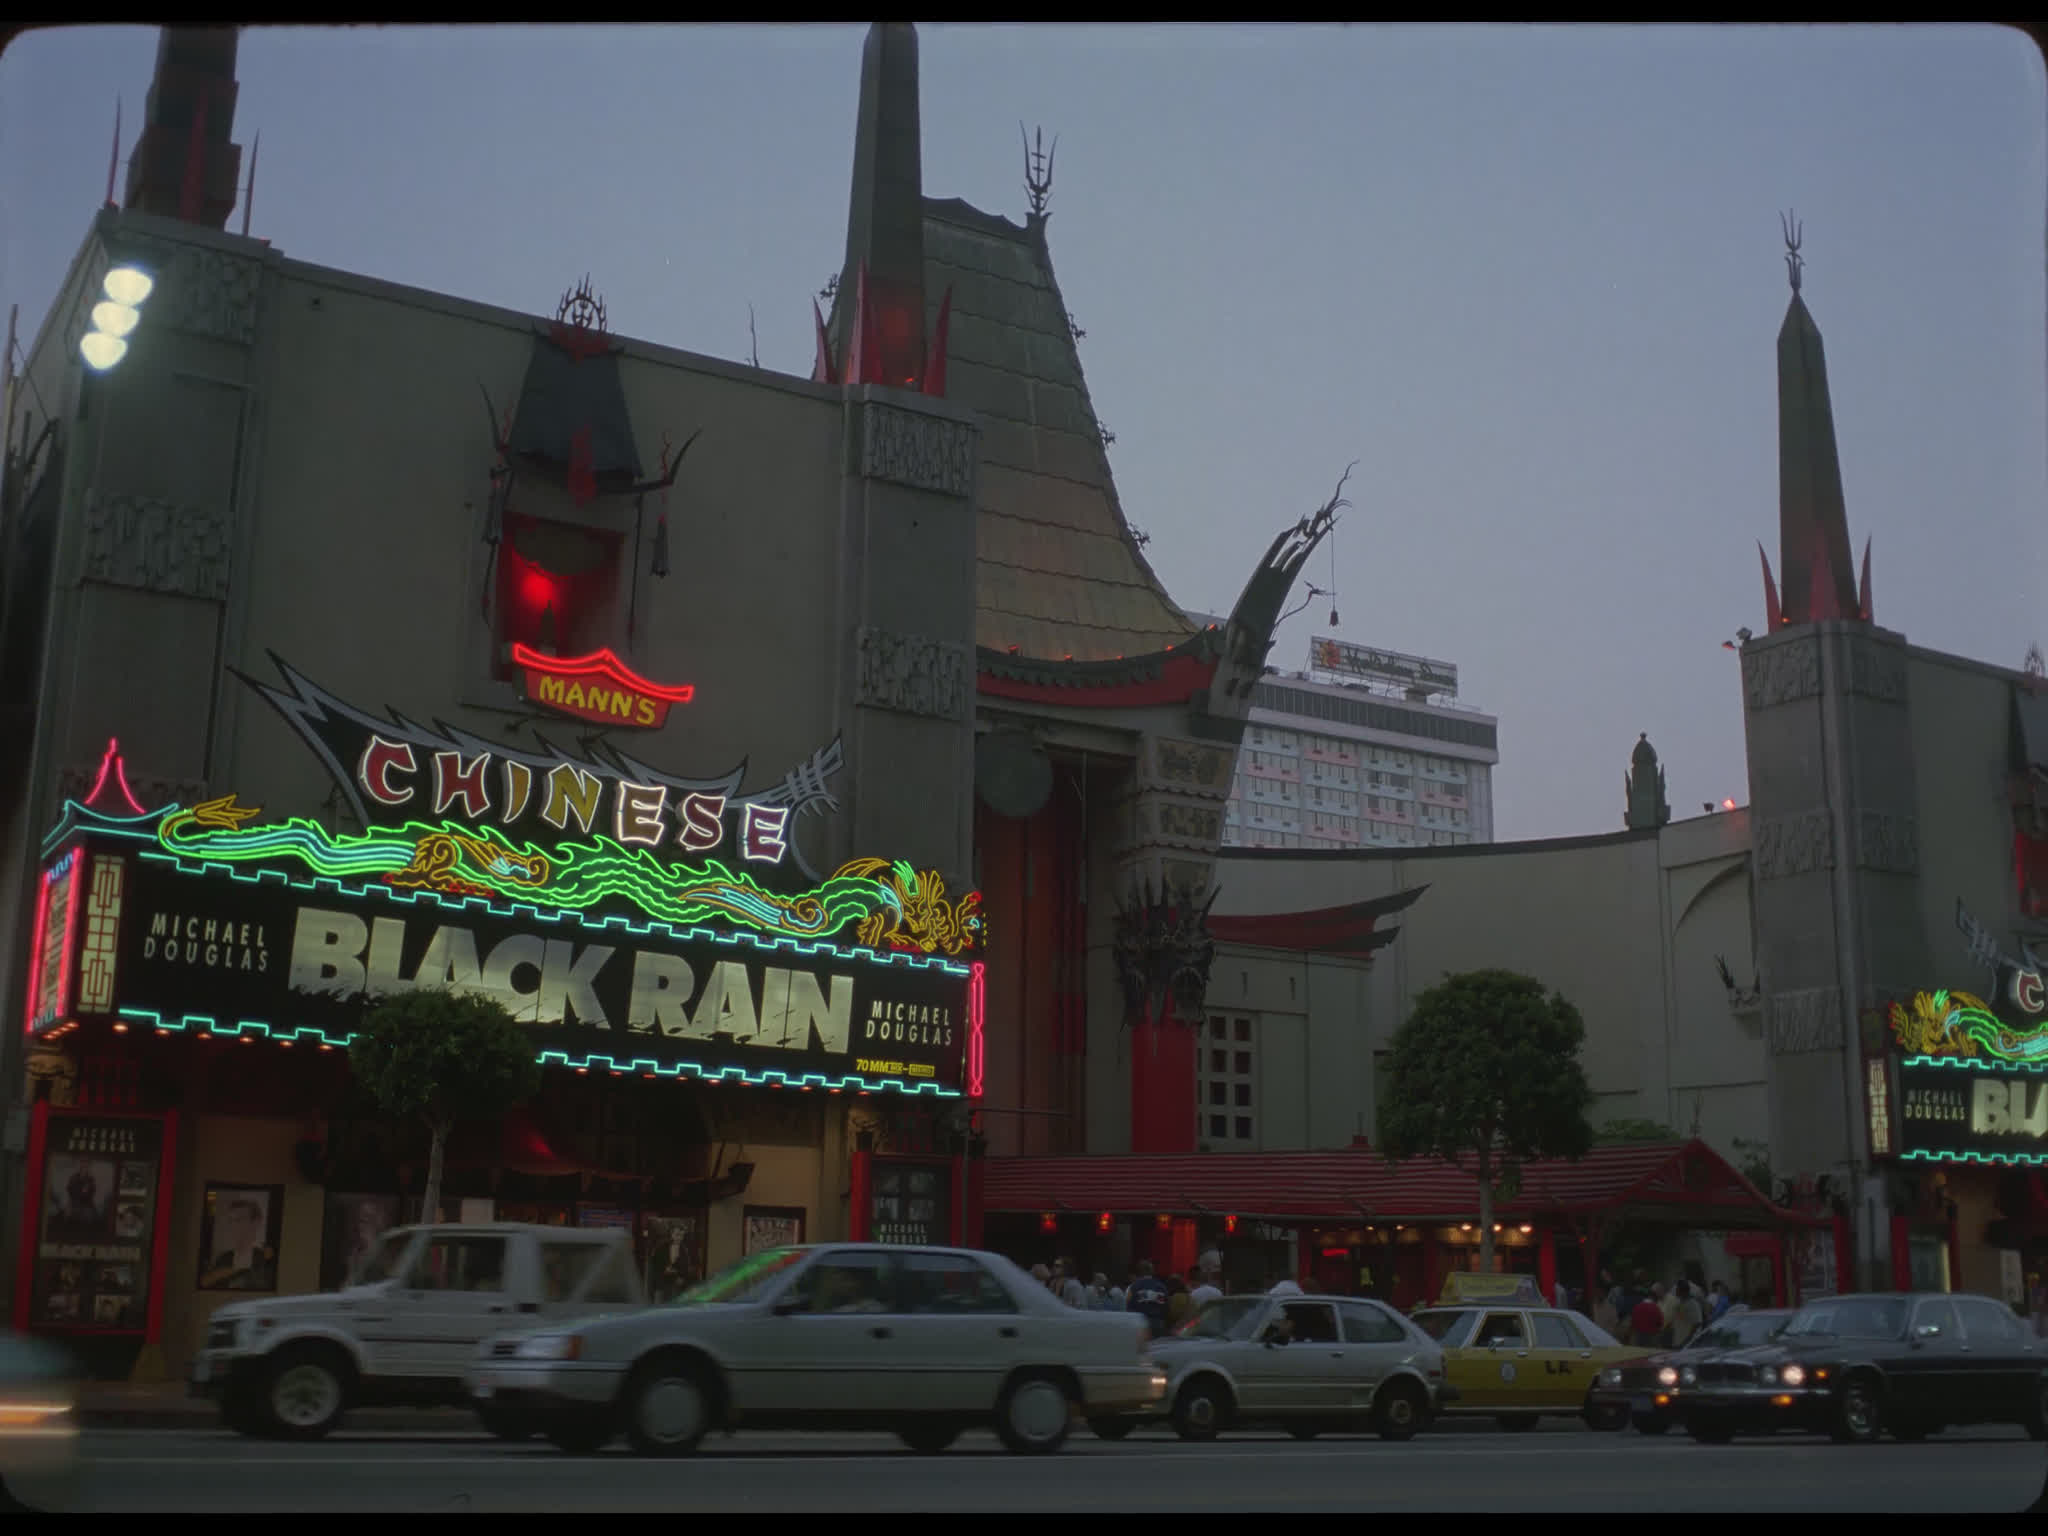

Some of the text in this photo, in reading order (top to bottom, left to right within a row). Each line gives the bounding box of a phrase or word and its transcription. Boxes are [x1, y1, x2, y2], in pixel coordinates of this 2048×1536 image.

[538, 675, 656, 726] MANN'S
[361, 736, 788, 863] CHINESE
[151, 912, 265, 947] MICHAEL
[143, 936, 269, 973] DOUGLAS
[288, 906, 854, 1055] BLACK RAIN
[871, 1000, 950, 1026] MICHAEL
[865, 1019, 952, 1046] DOUGLAS
[1904, 1103, 1966, 1121] DOUGLAS
[1907, 1089, 1963, 1105] MICHAEL
